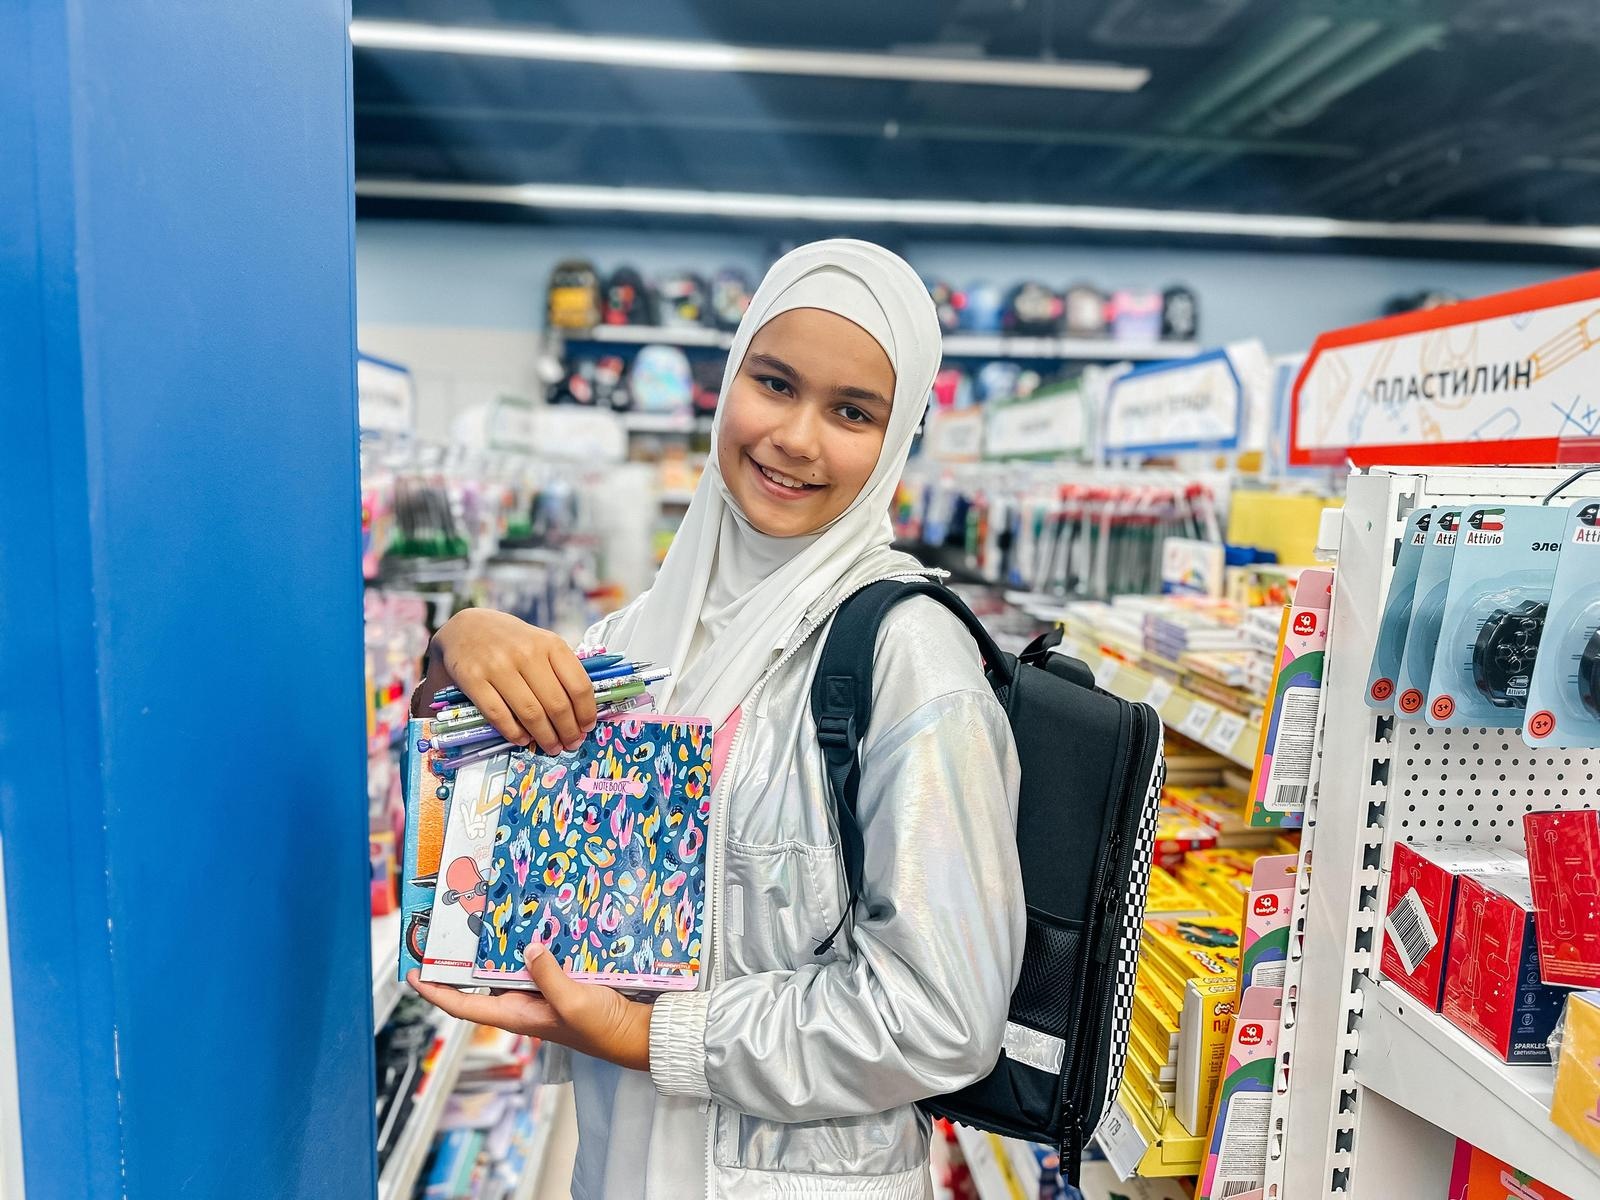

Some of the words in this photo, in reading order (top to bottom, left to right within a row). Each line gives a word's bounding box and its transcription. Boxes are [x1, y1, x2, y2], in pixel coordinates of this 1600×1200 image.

[1374, 359, 1531, 403] ПЛАСТИЛИН
[1467, 531, 1501, 544] Attivio
[1376, 685, 1388, 694] 3+
[1405, 697, 1417, 705] 3+
[1437, 703, 1449, 712] 3+
[1535, 720, 1549, 729] 3+
[593, 781, 627, 793] NOTEBOOK
[1240, 1035, 1260, 1043] BabyGo
[1107, 1117, 1122, 1136] 179
